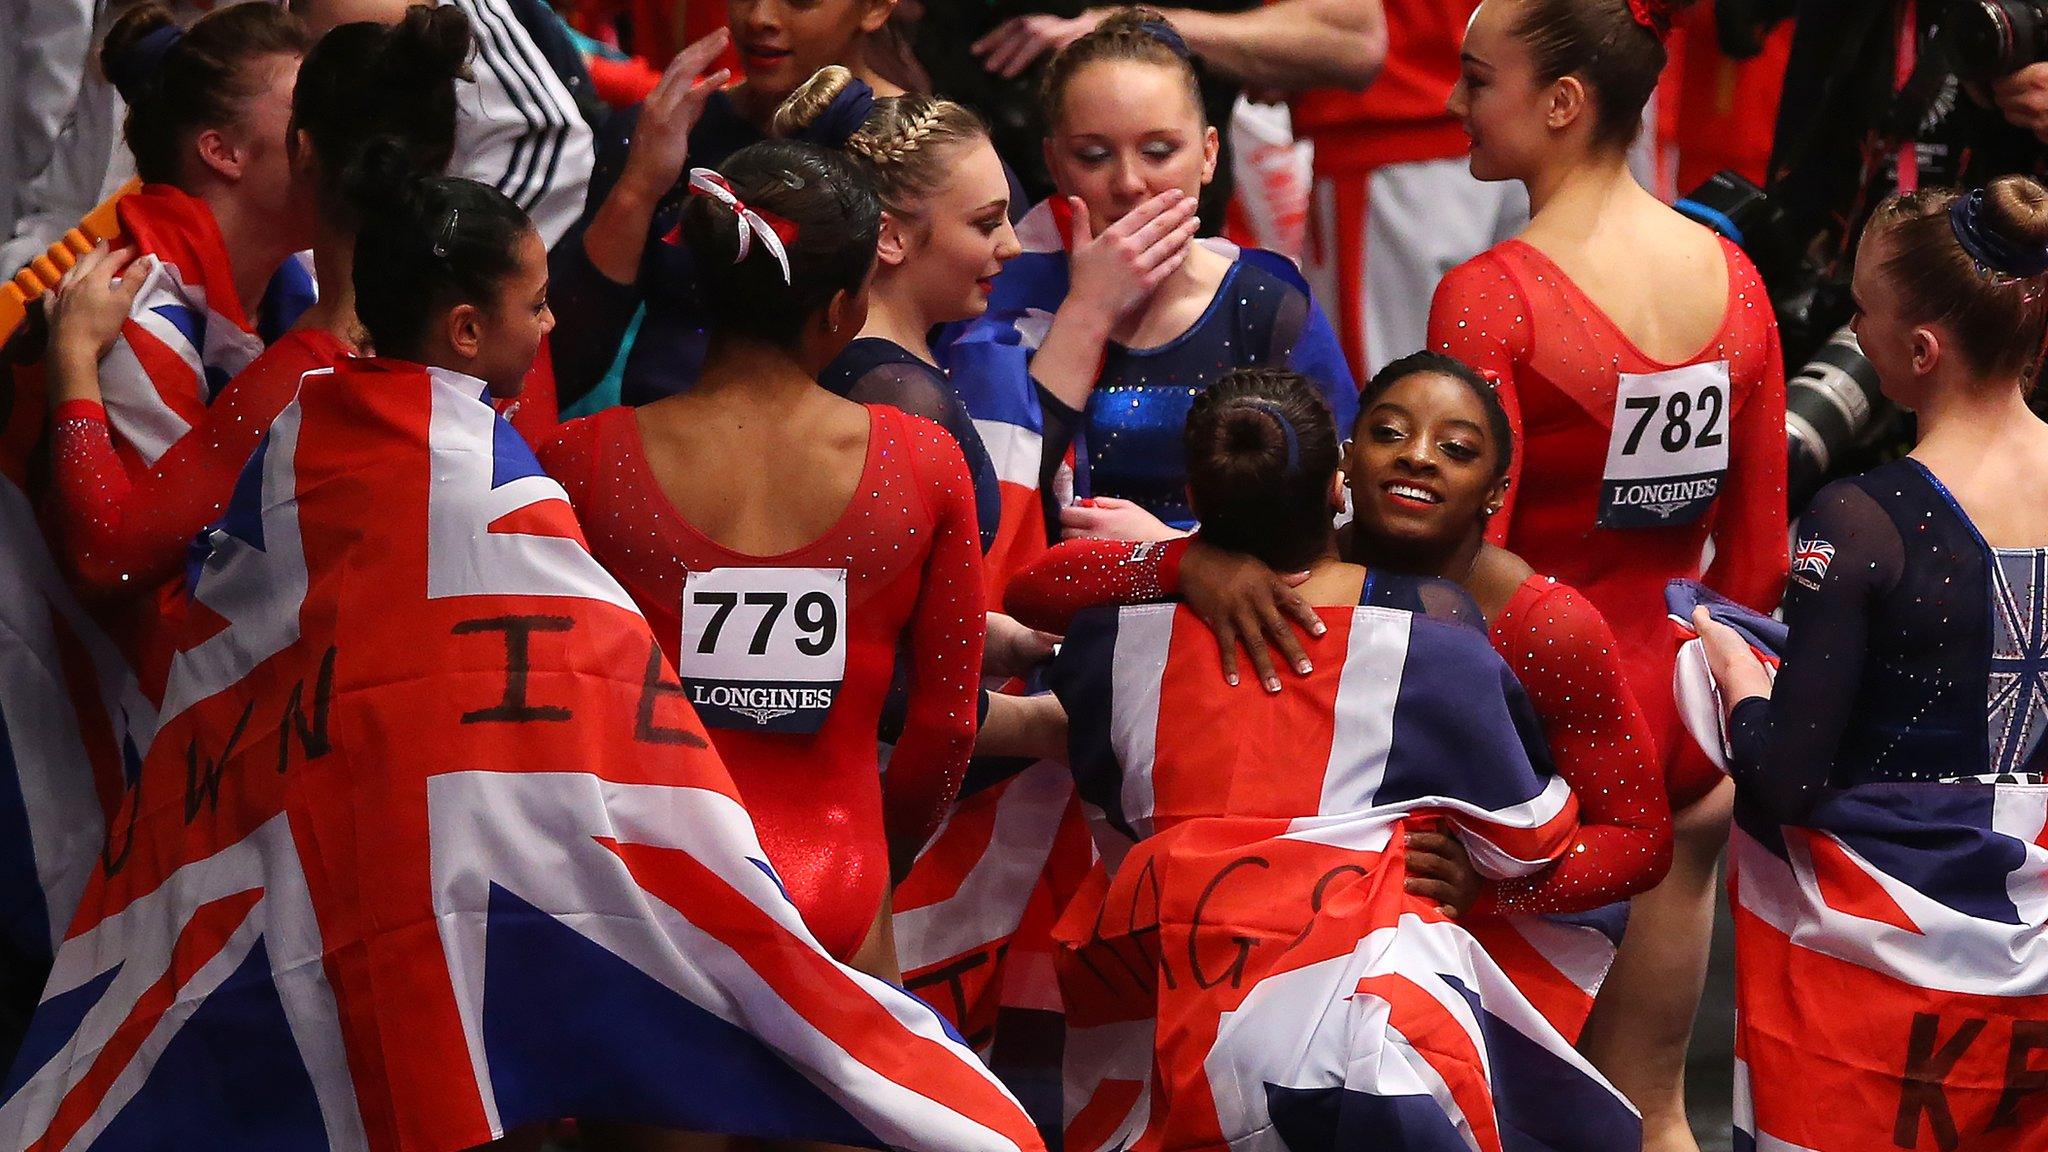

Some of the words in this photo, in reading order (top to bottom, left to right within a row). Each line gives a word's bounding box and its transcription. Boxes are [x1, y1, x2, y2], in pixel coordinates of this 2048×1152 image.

[1622, 385, 1723, 455] 782
[1612, 478, 1718, 505] LONGINES
[693, 591, 838, 657] 779
[693, 685, 832, 709] LONGINES
